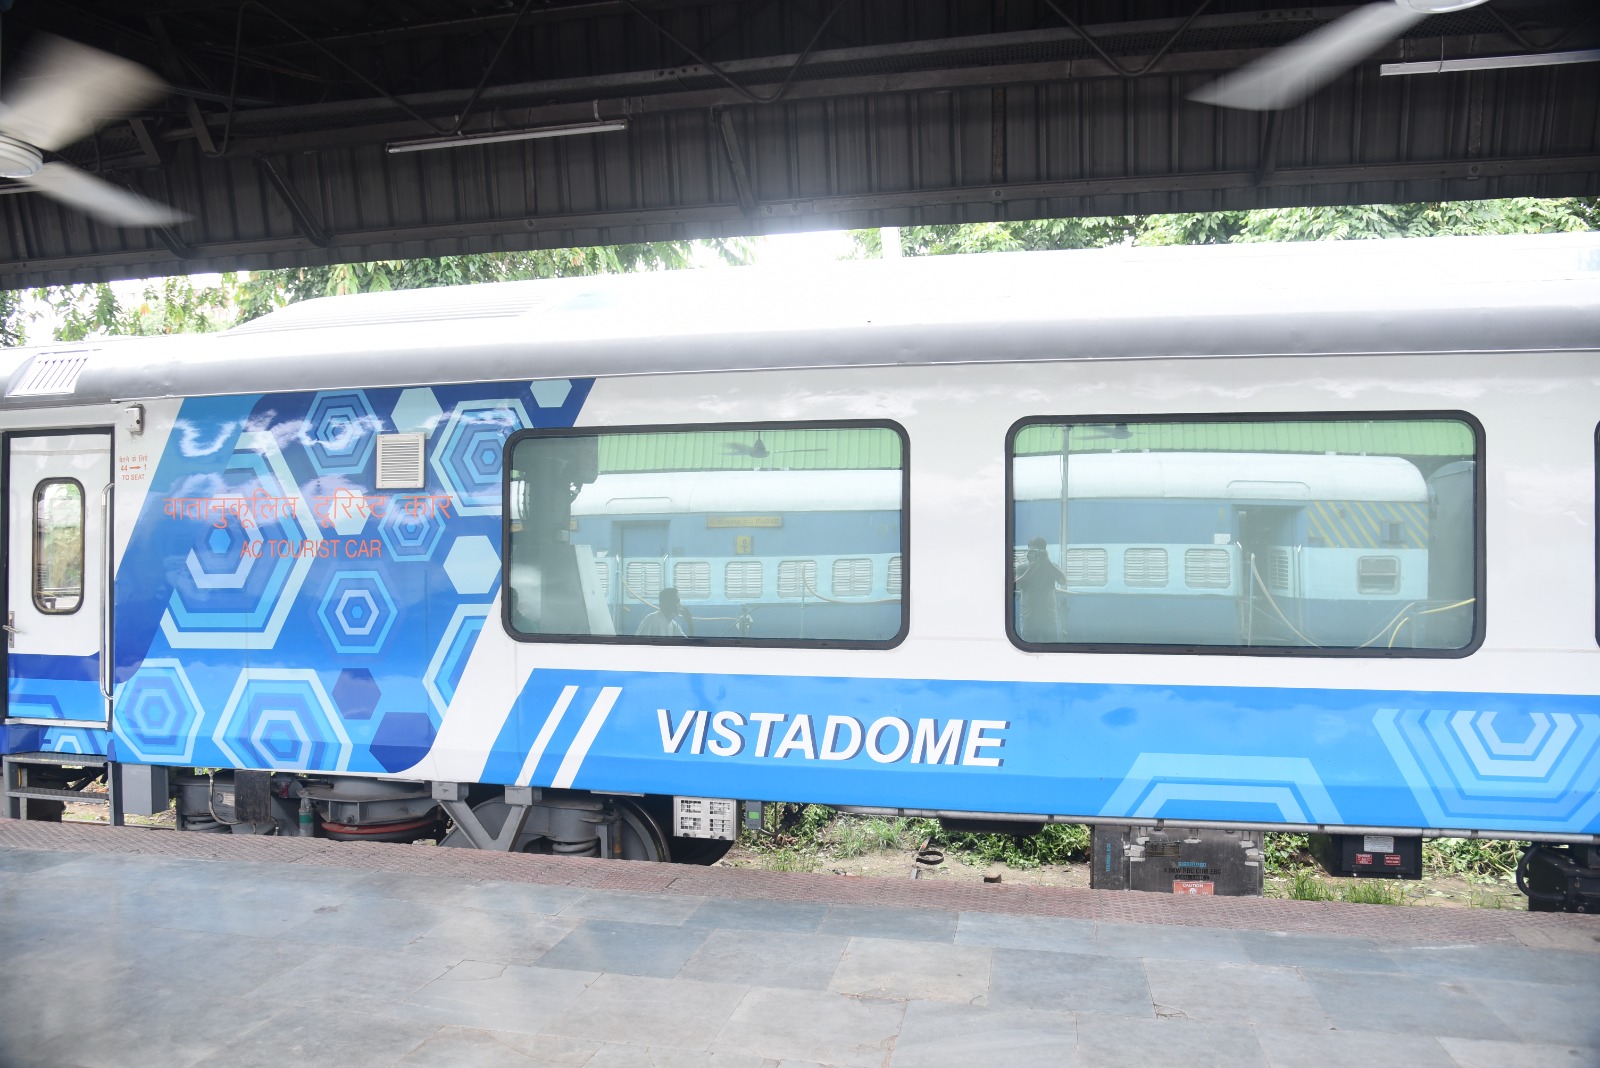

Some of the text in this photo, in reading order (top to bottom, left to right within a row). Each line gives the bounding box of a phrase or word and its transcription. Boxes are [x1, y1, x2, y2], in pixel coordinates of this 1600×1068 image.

[164, 488, 453, 528] वातानुकूलित टूरिस्ट कार
[240, 540, 382, 559] AC TOURIST CAR
[657, 709, 1011, 767] VISTADOME
